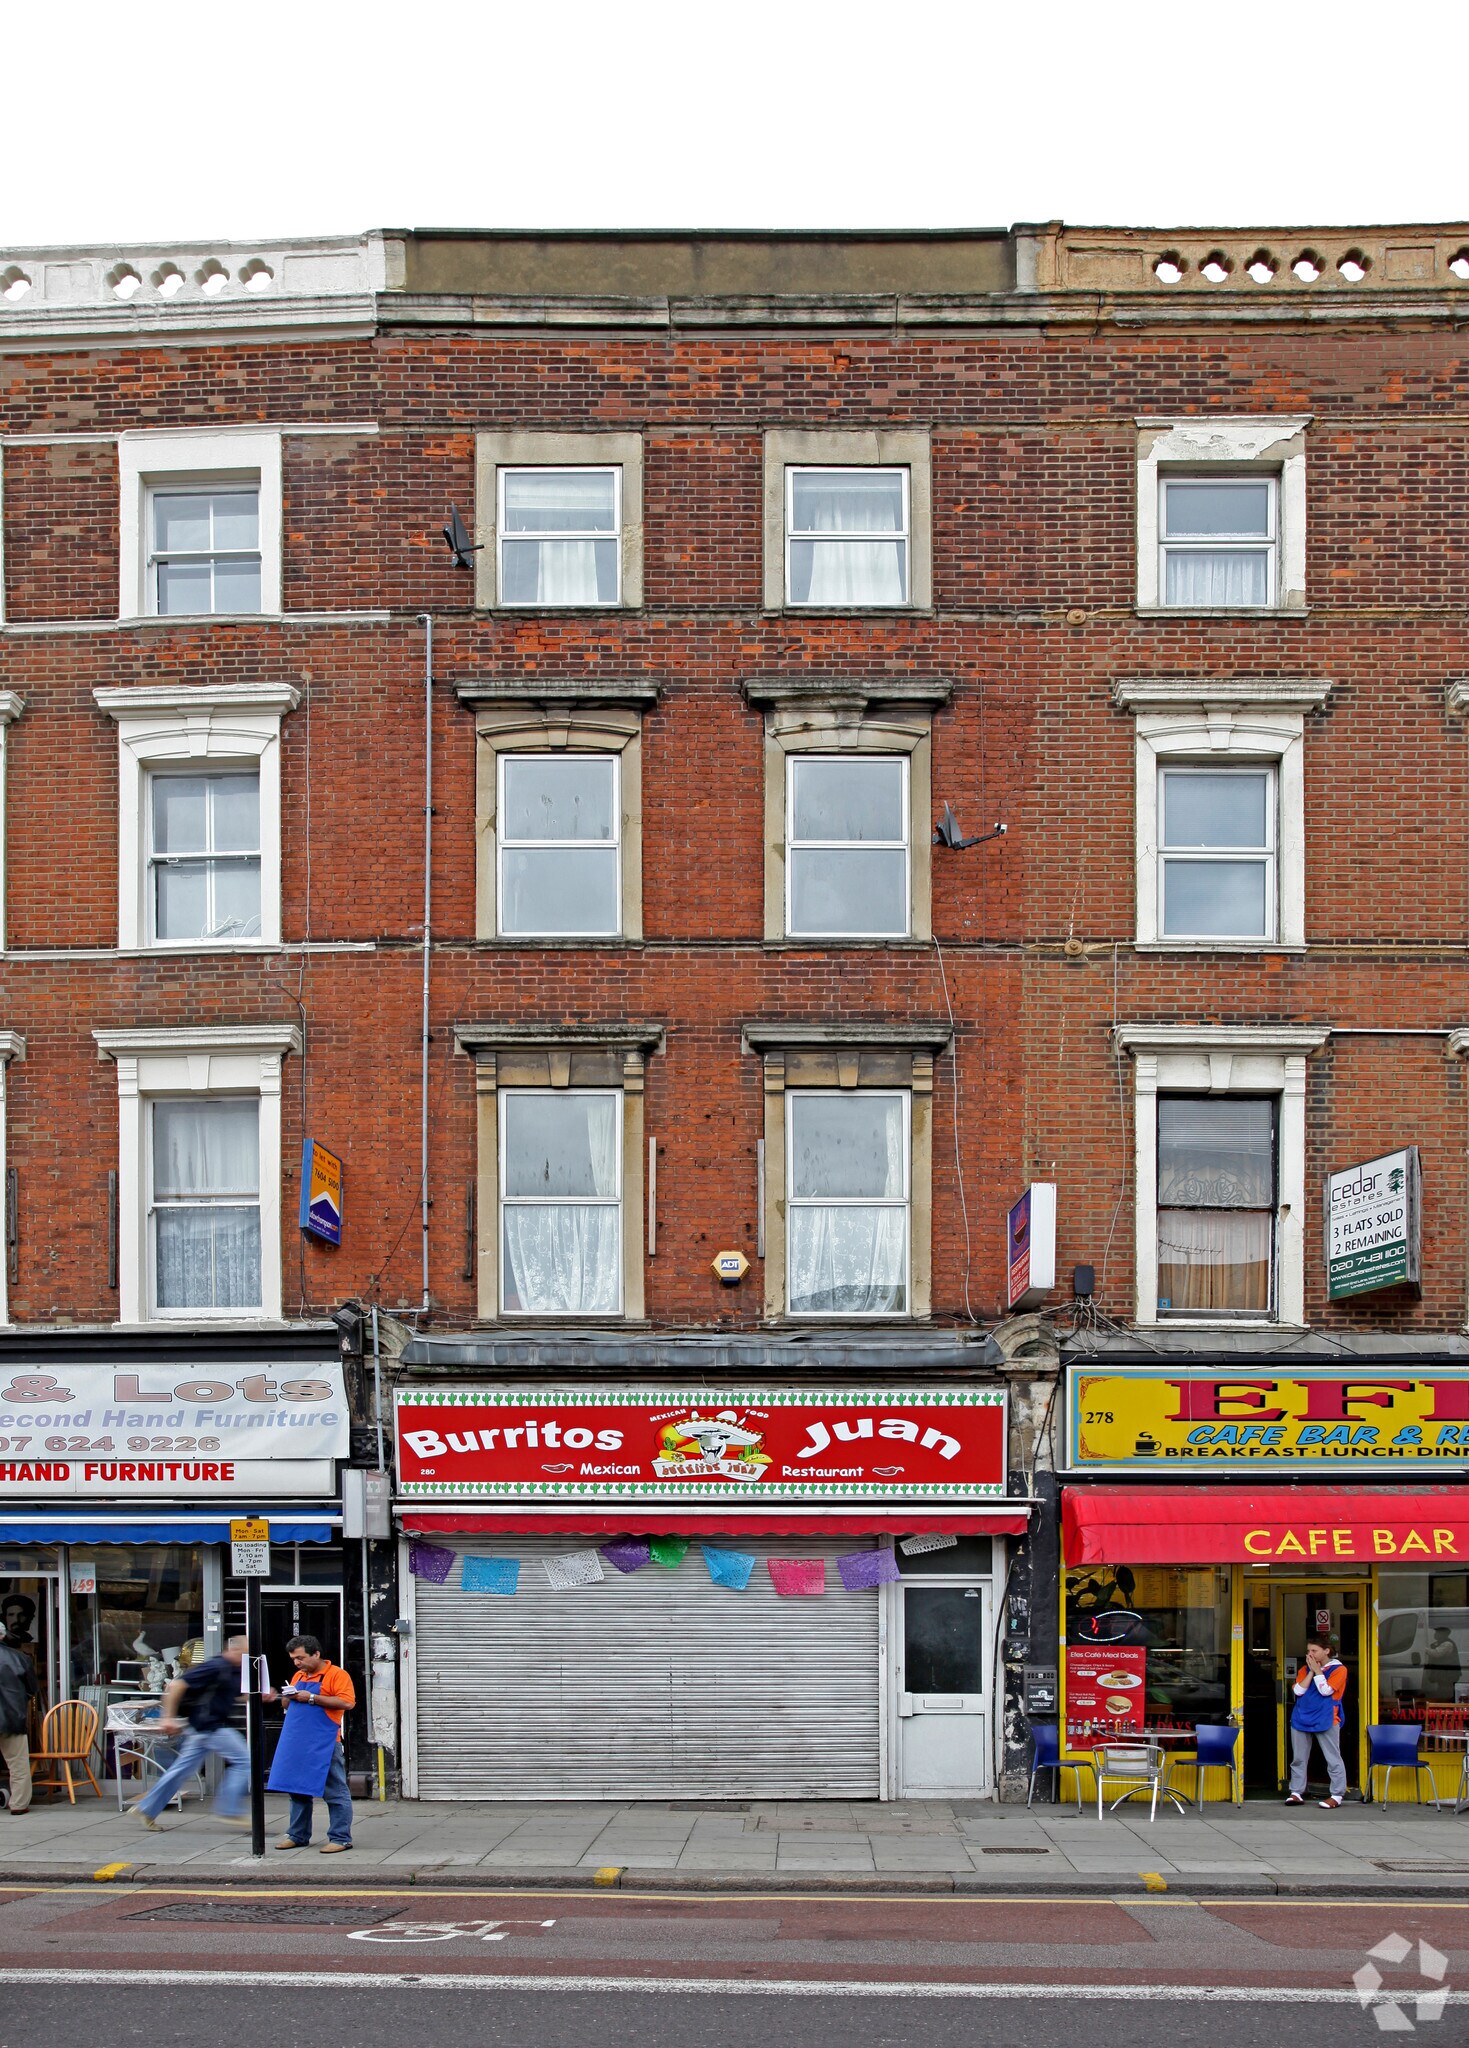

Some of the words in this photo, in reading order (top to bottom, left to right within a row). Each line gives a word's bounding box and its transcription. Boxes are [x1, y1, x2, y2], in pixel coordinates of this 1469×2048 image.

[1331, 1167, 1382, 1202] cedar
[1331, 1190, 1383, 1212] estates
[1333, 1227, 1339, 1238] 3
[1343, 1217, 1373, 1236] FLATS
[1376, 1208, 1403, 1226] SOLD
[1334, 1243, 1341, 1255] 2
[1345, 1225, 1402, 1252] REMAINING
[721, 1260, 738, 1269] ADT
[1330, 1260, 1353, 1273] 020
[1355, 1251, 1383, 1266] 7431
[0, 1374, 76, 1403] &
[113, 1374, 334, 1403] Lots
[102, 1409, 188, 1428] Hand
[194, 1408, 339, 1428] Furniture
[744, 1408, 769, 1419] FOOD
[1085, 1411, 1114, 1424] 278
[44, 1436, 115, 1452] 624
[127, 1436, 221, 1452] 9226
[402, 1420, 624, 1459] Burritos
[796, 1417, 962, 1460] Juan
[1187, 1425, 1287, 1446] CAFE
[1296, 1425, 1380, 1445] BAR
[1391, 1425, 1423, 1445] &
[1165, 1447, 1306, 1457] BREAKFAST
[1321, 1447, 1404, 1457] LUNCH
[0, 1463, 70, 1482] HAND
[84, 1462, 235, 1482] FURNITURE
[420, 1468, 436, 1476] 280
[580, 1462, 641, 1475] Mexican
[782, 1465, 864, 1478] Restaurant
[1244, 1529, 1355, 1555] CAFE
[1372, 1528, 1459, 1555] BAR
